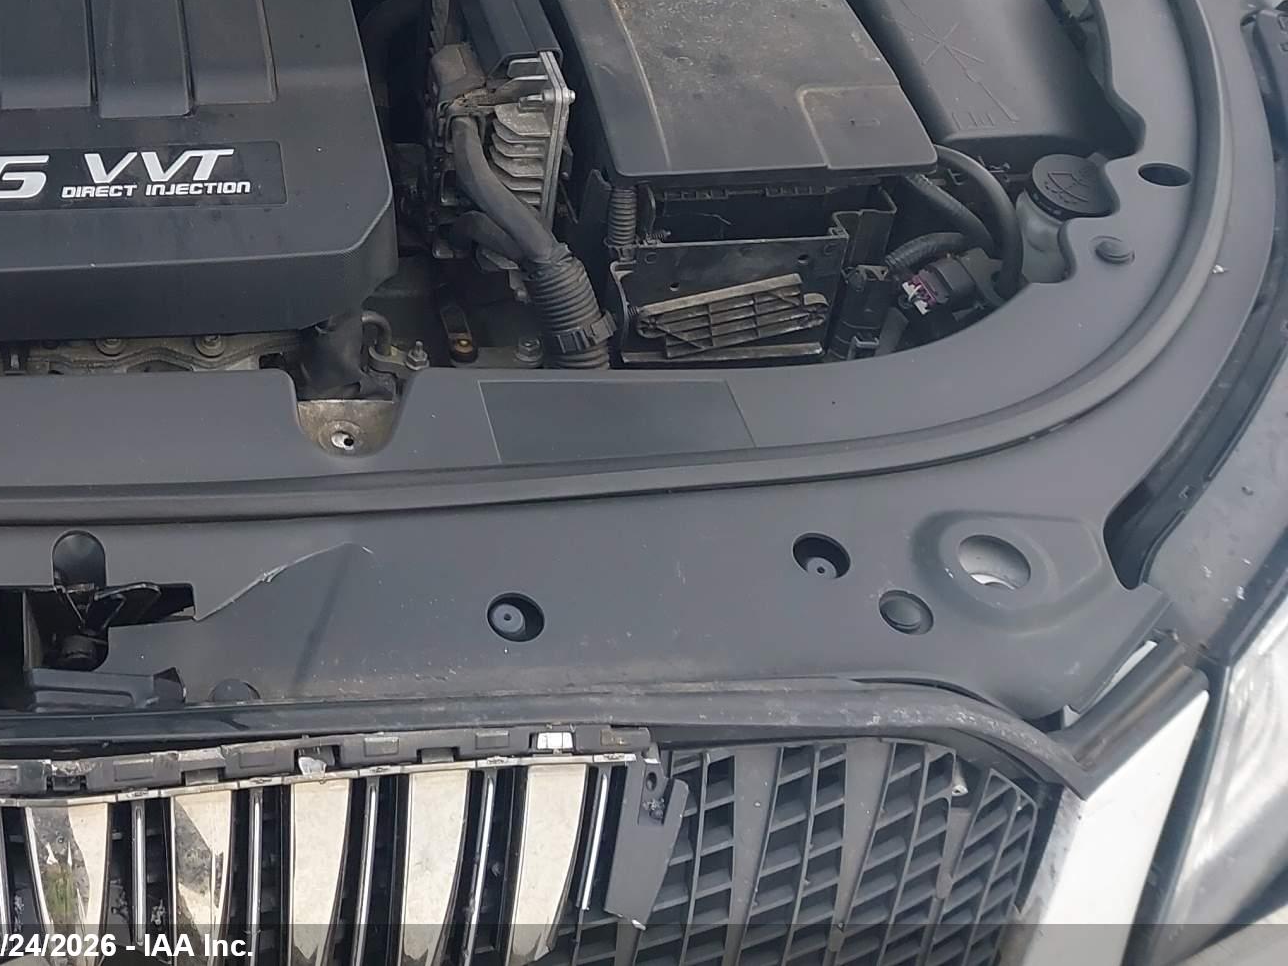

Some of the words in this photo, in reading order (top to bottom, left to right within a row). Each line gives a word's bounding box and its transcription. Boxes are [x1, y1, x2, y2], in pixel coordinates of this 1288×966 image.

[84, 149, 235, 183] VVT
[61, 184, 138, 198] DIRECT
[145, 180, 251, 196] INJECTION
